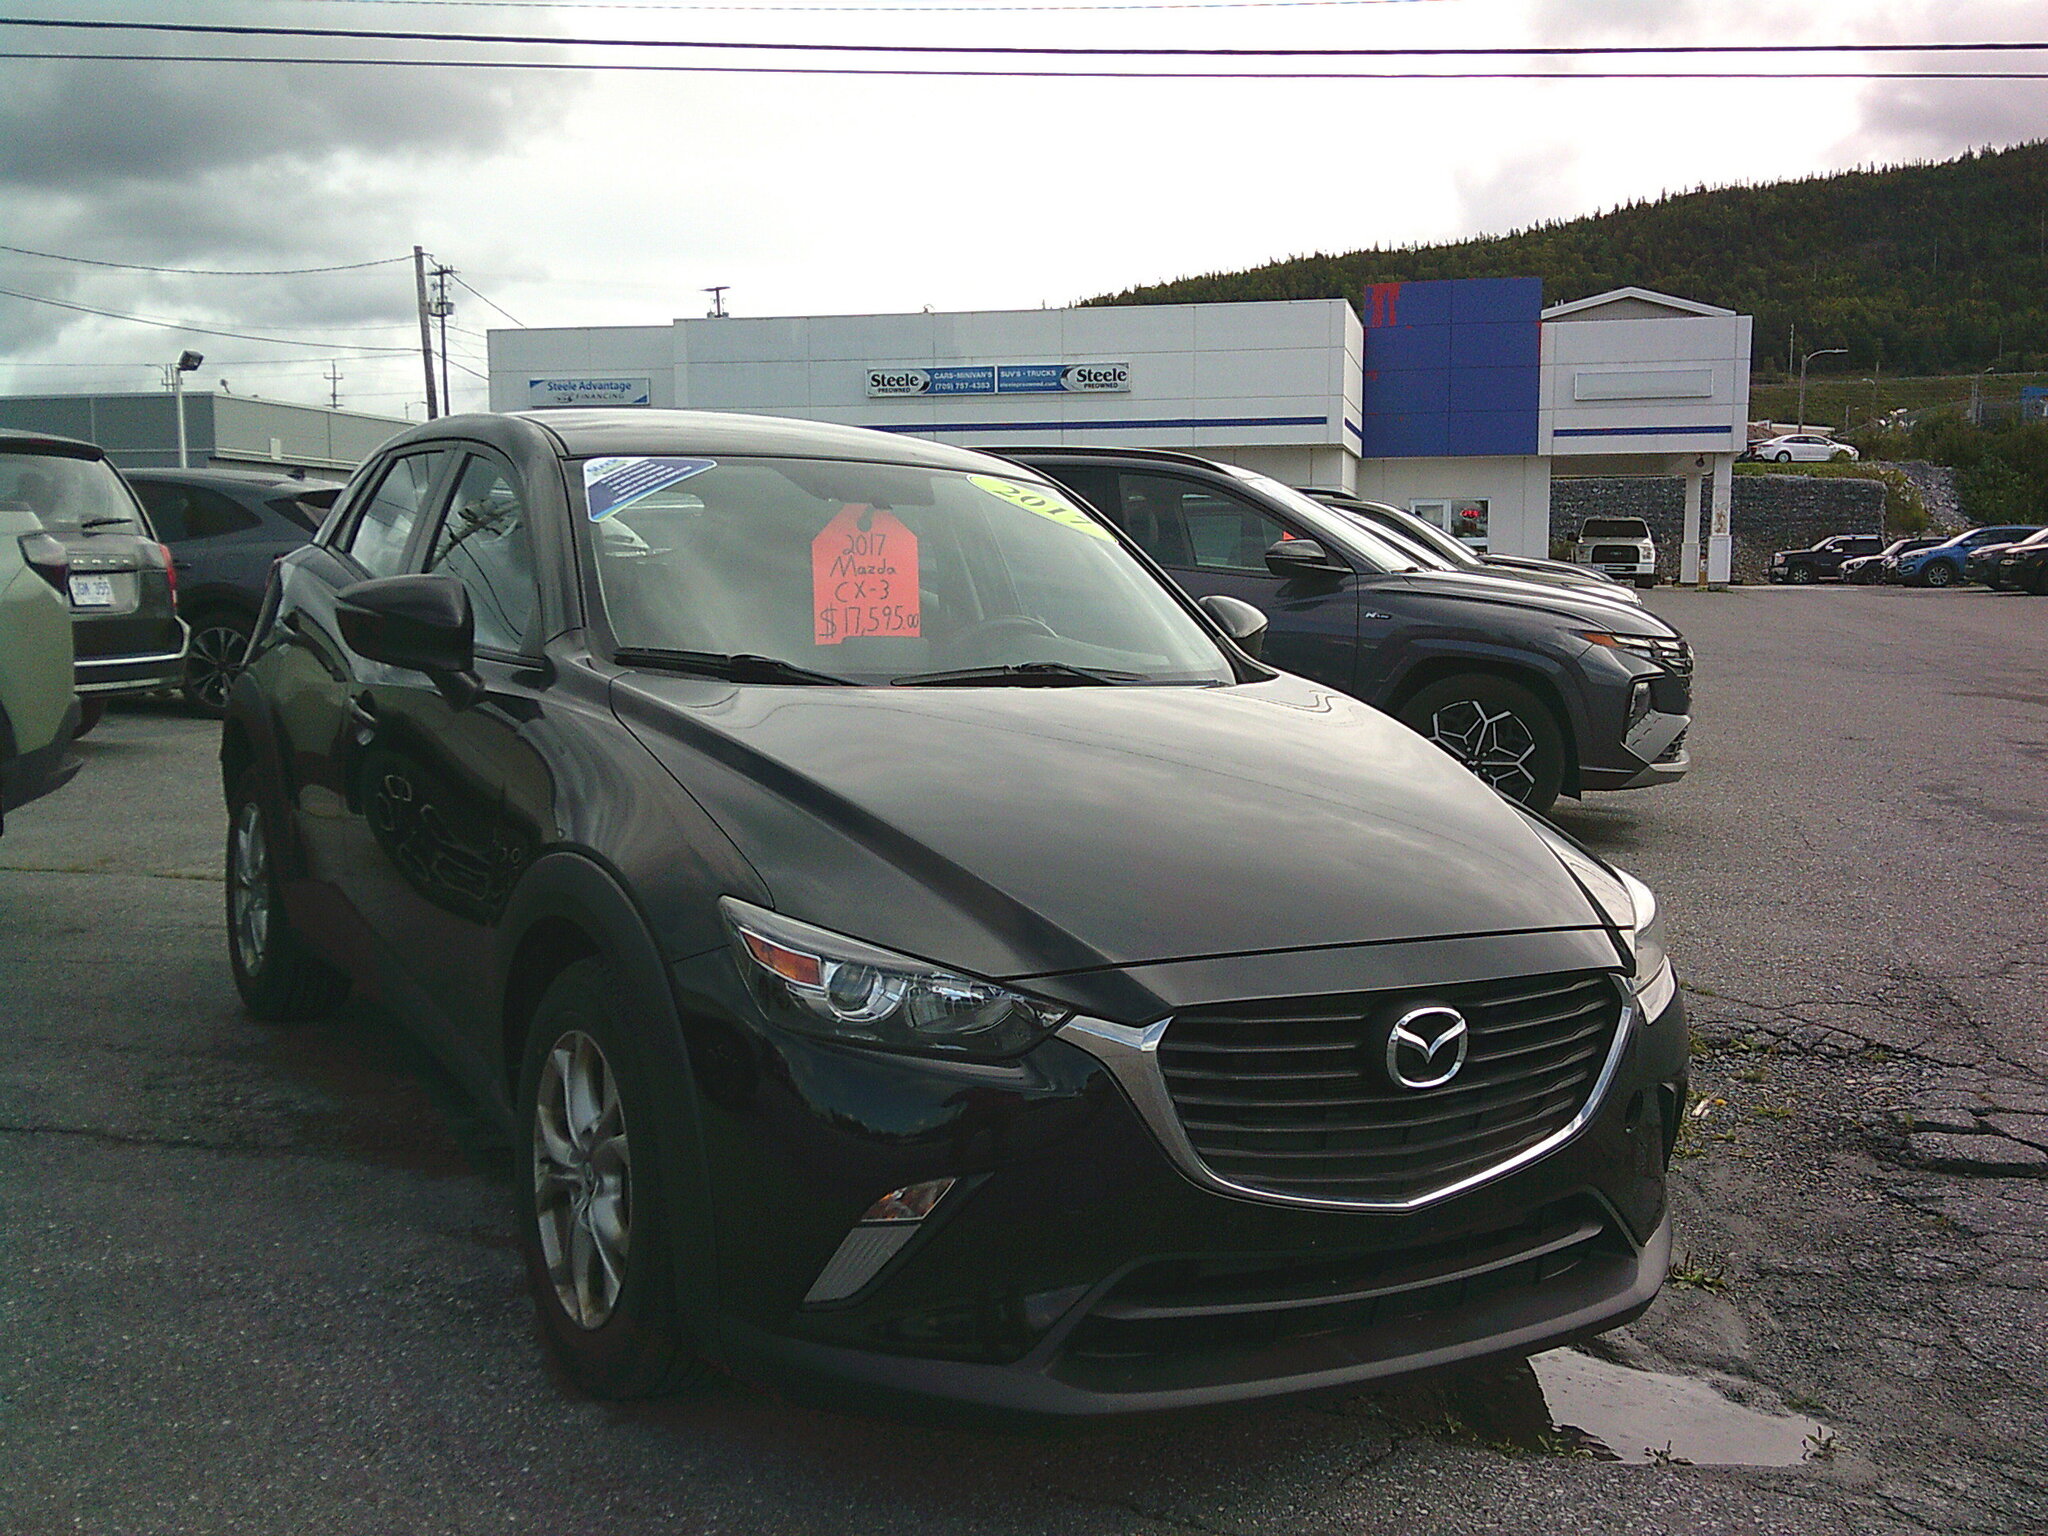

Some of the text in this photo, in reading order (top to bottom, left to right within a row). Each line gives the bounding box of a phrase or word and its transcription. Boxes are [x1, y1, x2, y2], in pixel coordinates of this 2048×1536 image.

[870, 374, 919, 388] Steele
[1076, 368, 1127, 383] Steele
[547, 381, 632, 393] Steele Advantage
[575, 393, 624, 401] FINANCING
[992, 486, 1093, 524] 2017
[842, 534, 886, 556] 2017
[830, 556, 896, 577] Mazda
[834, 579, 890, 603] CX-3
